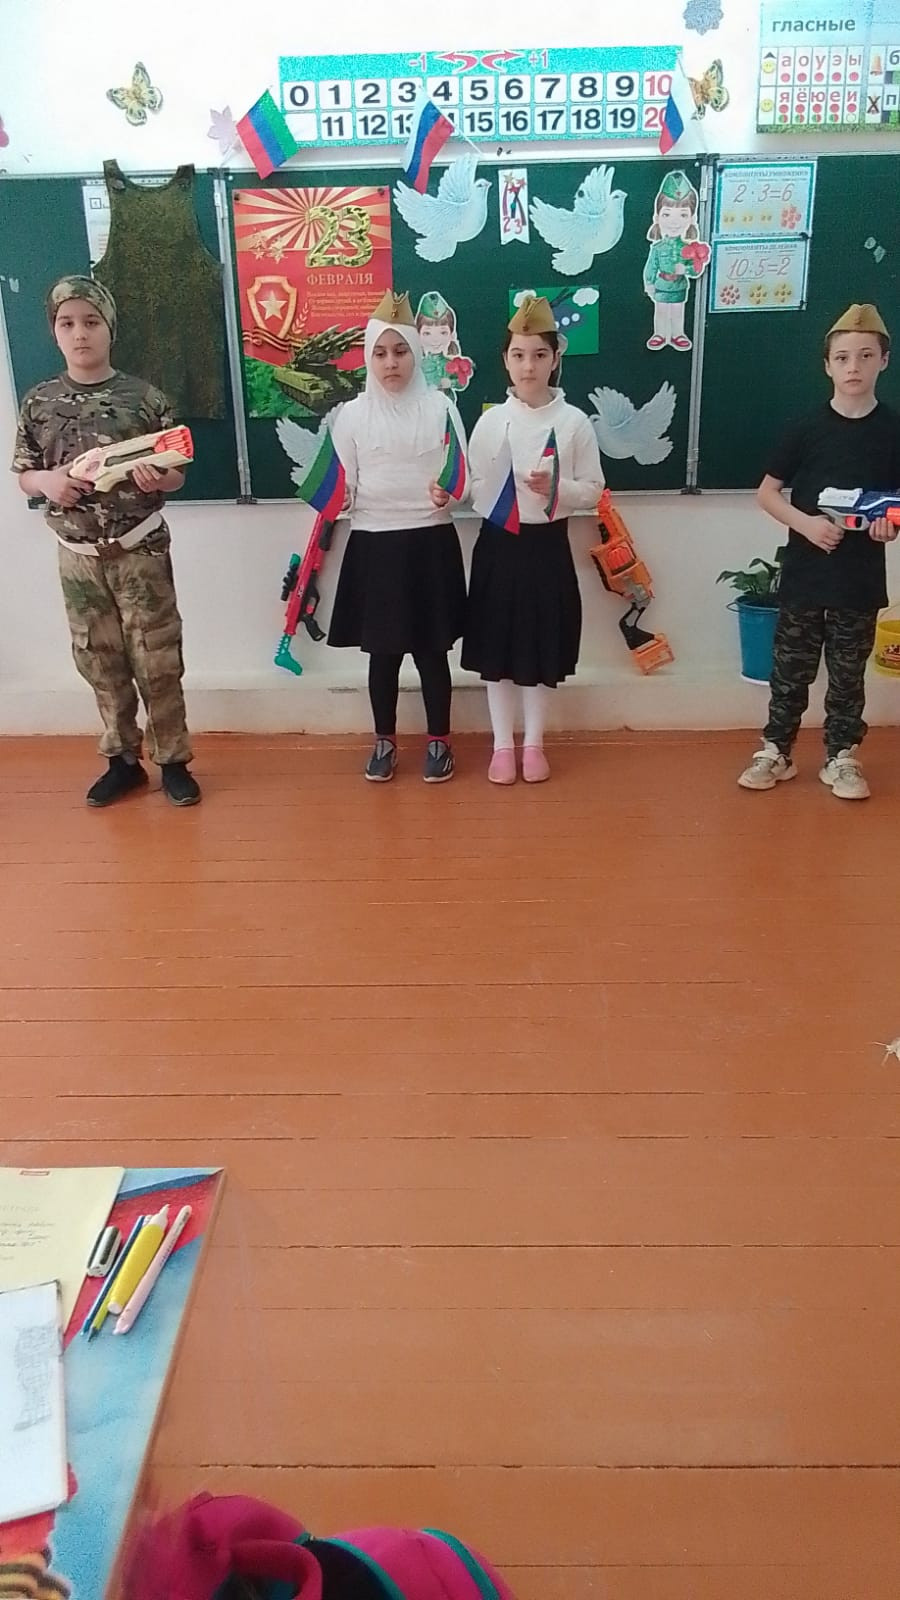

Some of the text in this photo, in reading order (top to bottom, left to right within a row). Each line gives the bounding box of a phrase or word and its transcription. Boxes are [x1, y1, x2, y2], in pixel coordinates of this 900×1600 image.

[772, 19, 856, 32] гласные
[409, 55, 426, 71] -1
[529, 51, 547, 67] +1
[782, 55, 862, 70] а о у э ы
[289, 74, 672, 106] 0 1 2 3 4 5 6 7 8 9 10
[780, 88, 857, 102] я ё ю е и
[886, 94, 897, 105] п
[322, 116, 344, 137] 11
[359, 114, 386, 135] 12
[465, 111, 493, 132] 15
[501, 109, 528, 131] 16
[537, 109, 564, 130] 17
[572, 108, 600, 130] 18
[609, 107, 636, 129] 19
[503, 216, 523, 235] 23
[304, 205, 373, 268] 23
[307, 272, 374, 285] ФЕВРАЛЯ
